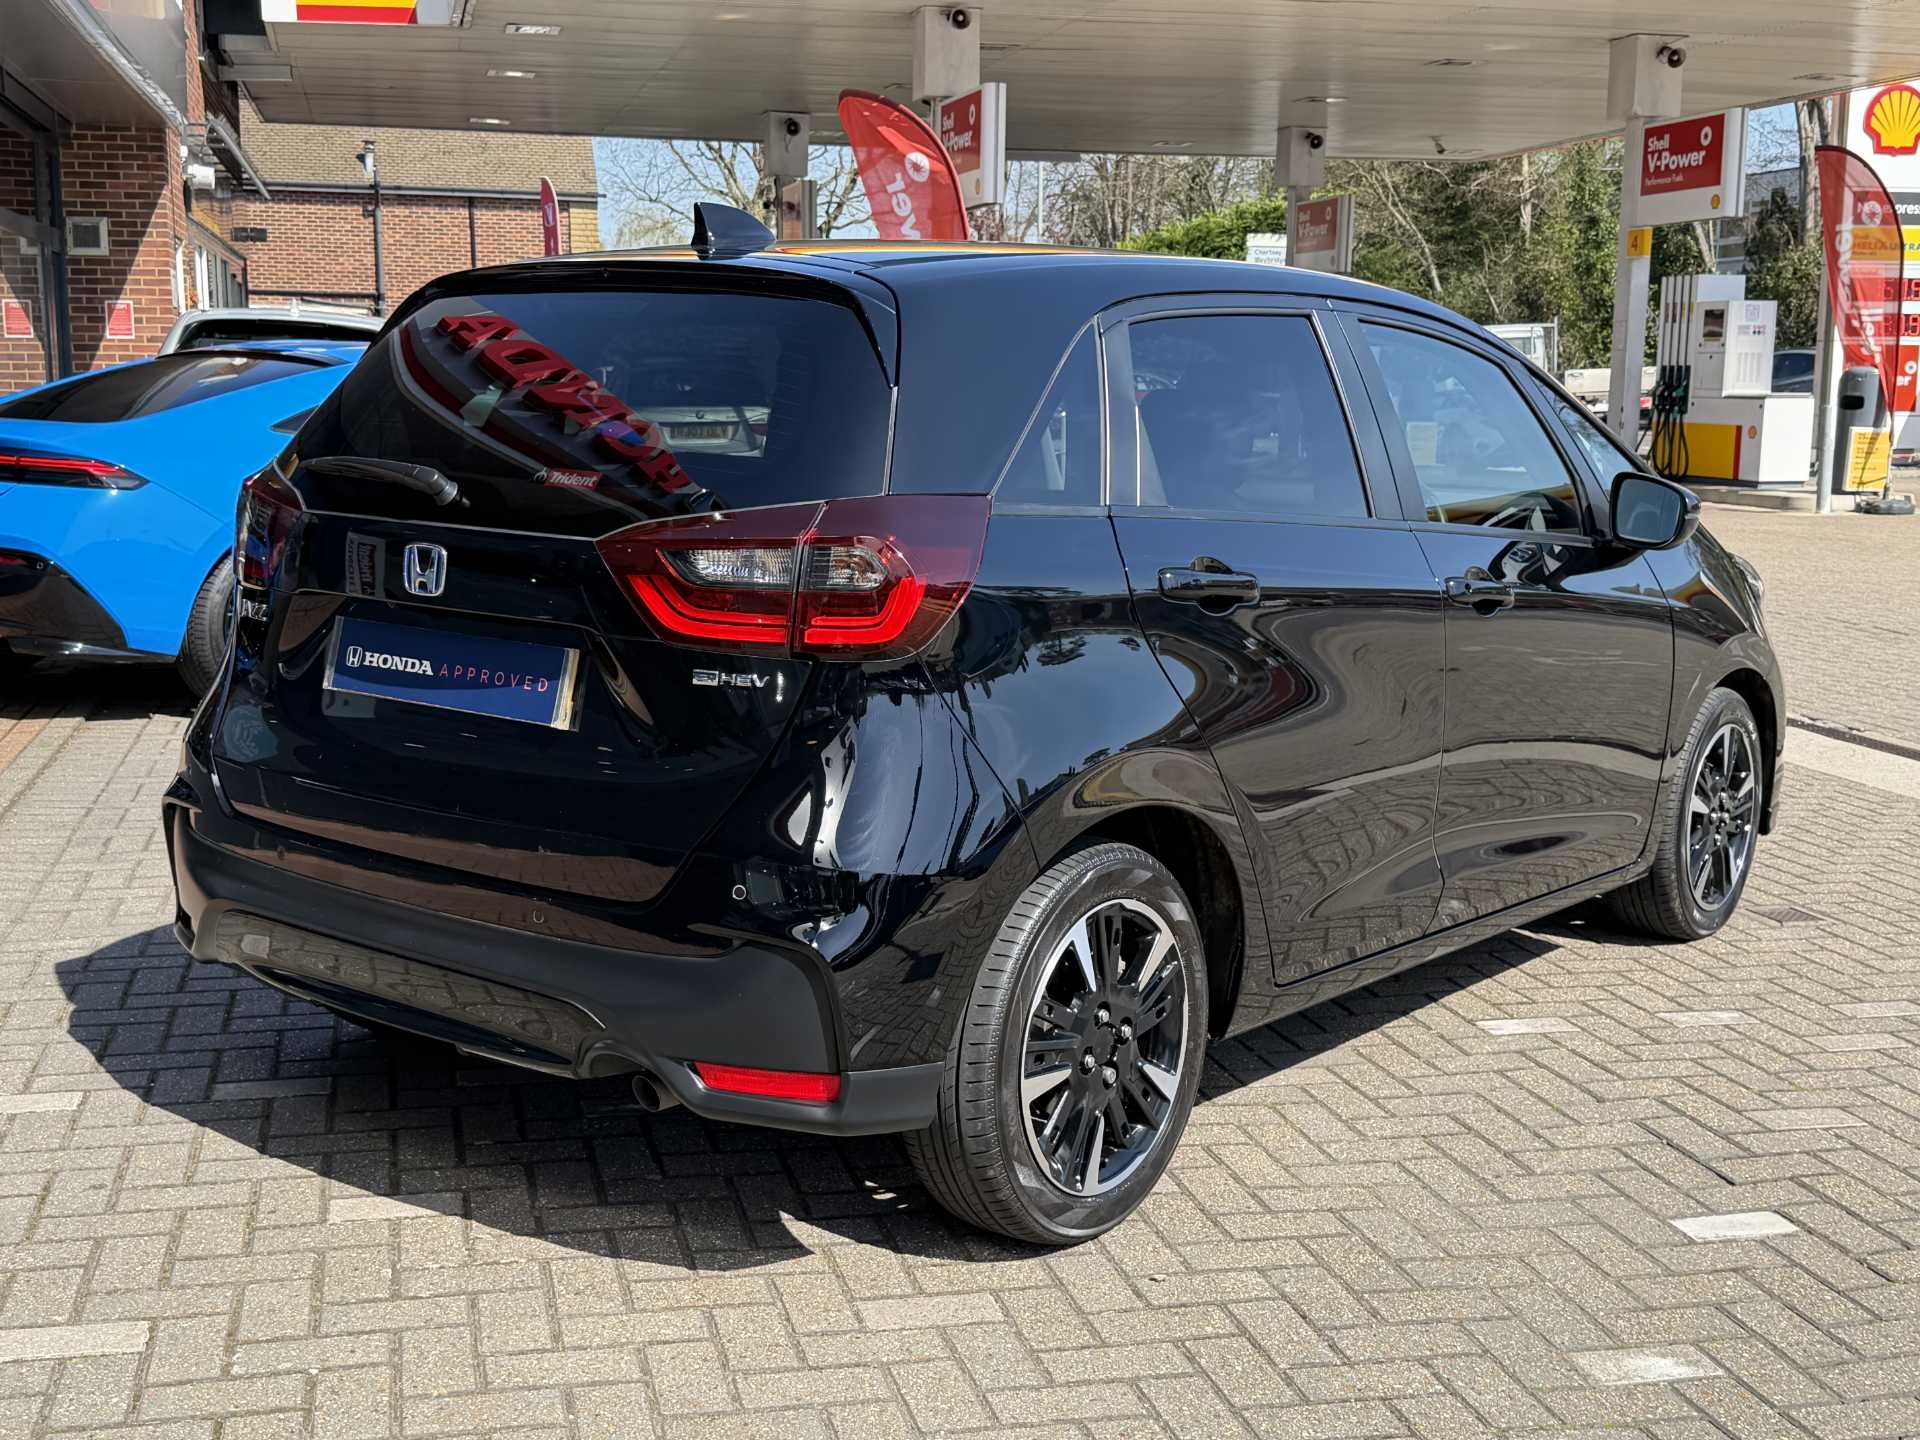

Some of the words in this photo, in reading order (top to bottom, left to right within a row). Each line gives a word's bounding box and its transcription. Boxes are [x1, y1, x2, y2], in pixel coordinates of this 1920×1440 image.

[1647, 134, 1670, 152] Shell
[1647, 149, 1706, 174] V-Power
[1631, 235, 1638, 251] 4
[549, 470, 599, 487] Trident
[364, 650, 433, 676] HONDA
[438, 662, 548, 692] APPROVED
